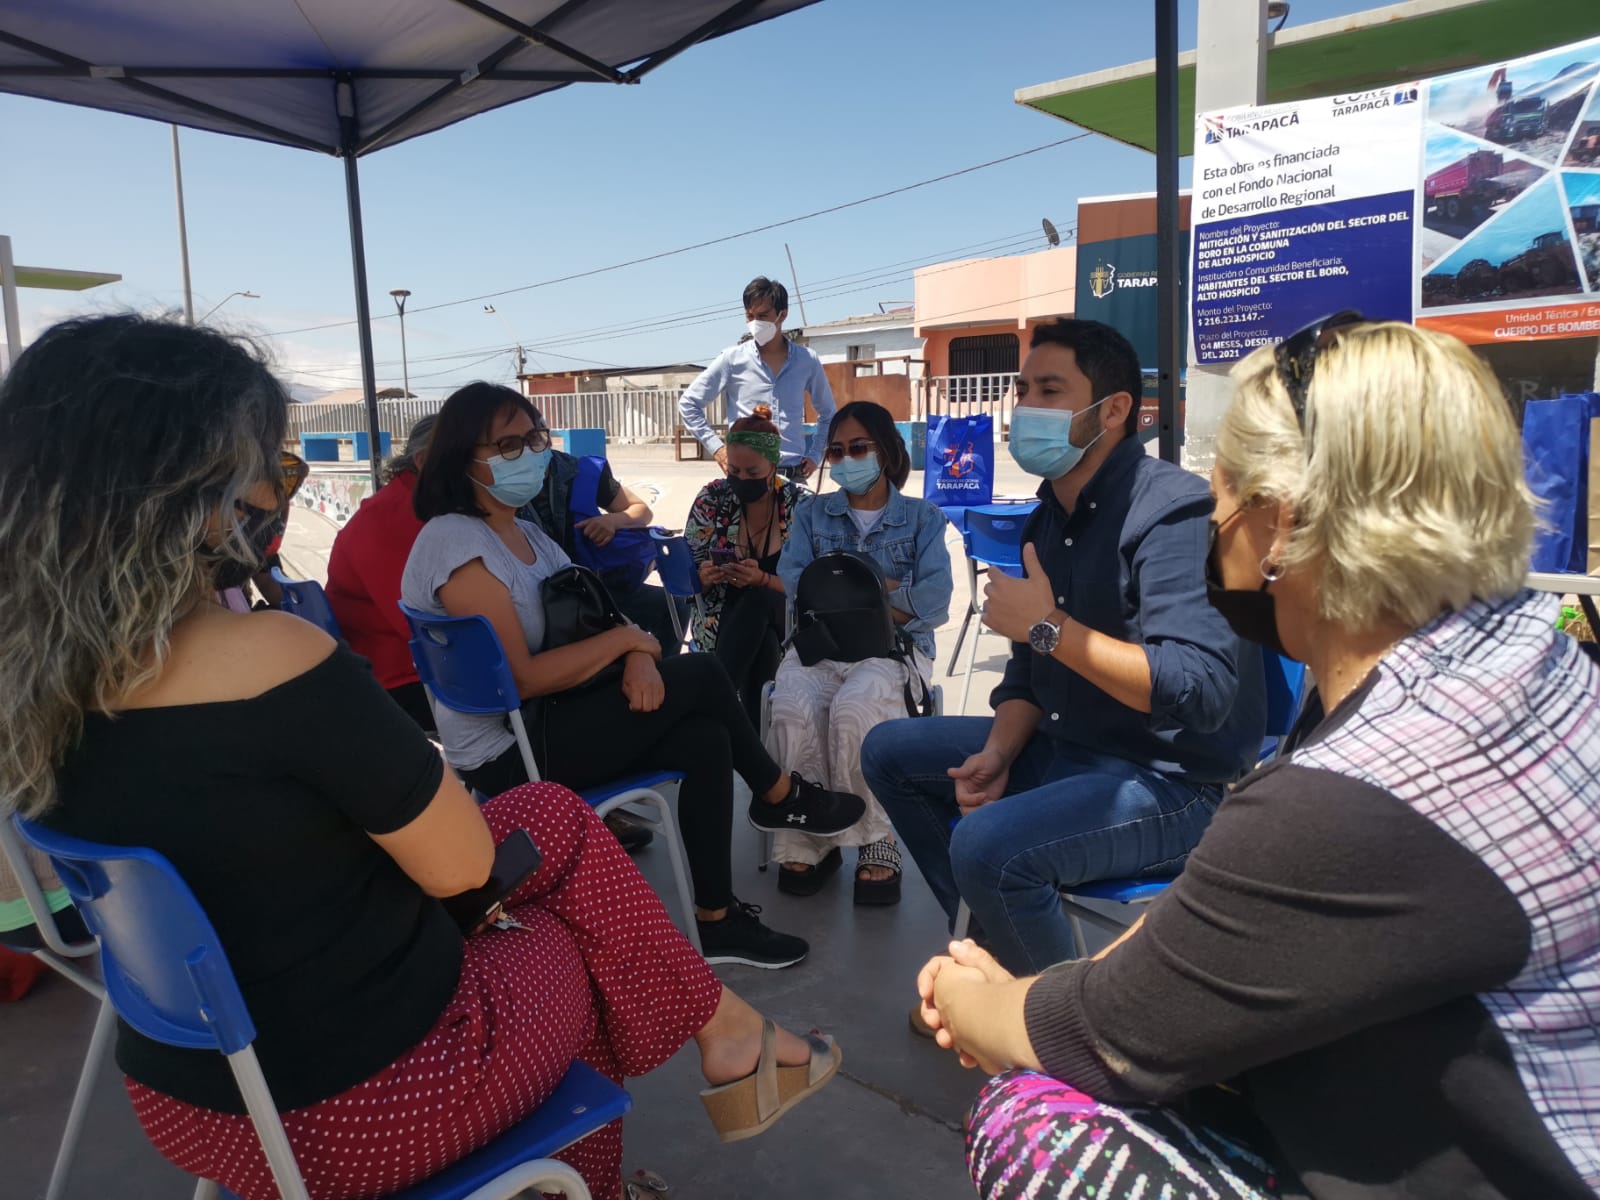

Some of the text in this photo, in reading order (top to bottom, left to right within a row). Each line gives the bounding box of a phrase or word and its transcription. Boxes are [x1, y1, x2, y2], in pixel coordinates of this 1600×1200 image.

[1332, 96, 1390, 117] TARAPACÁ
[1203, 168, 1228, 181] Esta
[1230, 162, 1254, 175] obra
[1273, 144, 1340, 167] financiada
[1202, 164, 1333, 200] con el Fondo Nacional
[1201, 184, 1336, 219] de Desarrollo Regional
[1199, 211, 1409, 249] MITIGACIÓN Y SANITIZACIÓN DEL SECTOR DEL
[1199, 221, 1280, 240] Nombre del Proyecto:
[1199, 238, 1289, 260] BORO EN LA COMUNA
[1198, 250, 1275, 270] DE ALTO HOSPICIO
[1245, 262, 1290, 276] Comunidad
[1291, 256, 1343, 270] Beneficiaria:
[1198, 266, 1349, 292] HABITANTES DEL SECTOR EL BORO,
[1197, 286, 1260, 302] ALTO HOSPICIO
[1197, 302, 1273, 318] Monto del Proyecto:
[1505, 311, 1542, 323] Unidad
[1221, 331, 1232, 339] del
[1494, 319, 1600, 338] CUERPO DE BOMBE
[1200, 342, 1211, 351] 04
[1213, 339, 1244, 349] MESES,
[1244, 336, 1273, 347] DESDE
[1202, 349, 1240, 360] DEL 2021
